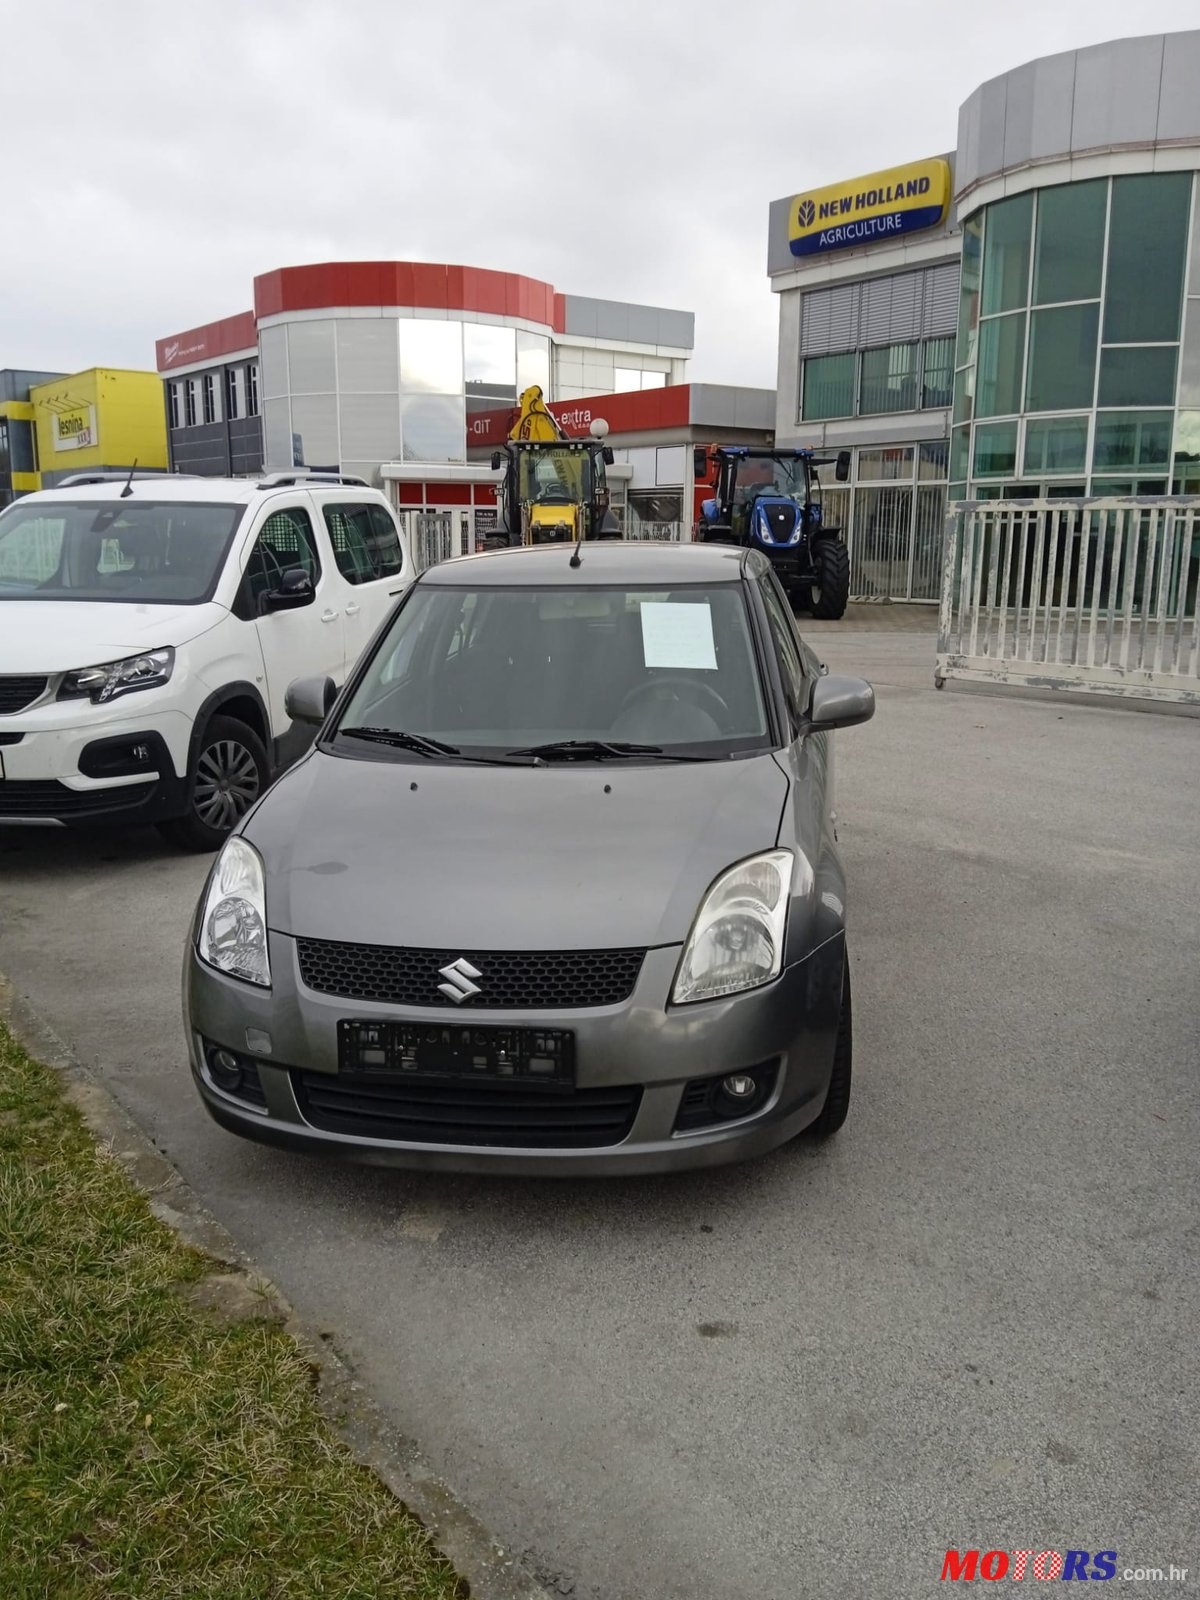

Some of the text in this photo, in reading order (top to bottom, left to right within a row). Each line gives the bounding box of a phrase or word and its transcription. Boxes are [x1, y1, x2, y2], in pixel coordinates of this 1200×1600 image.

[819, 177, 930, 219] NEW HOLLAND
[819, 214, 902, 246] AGRICULTURE
